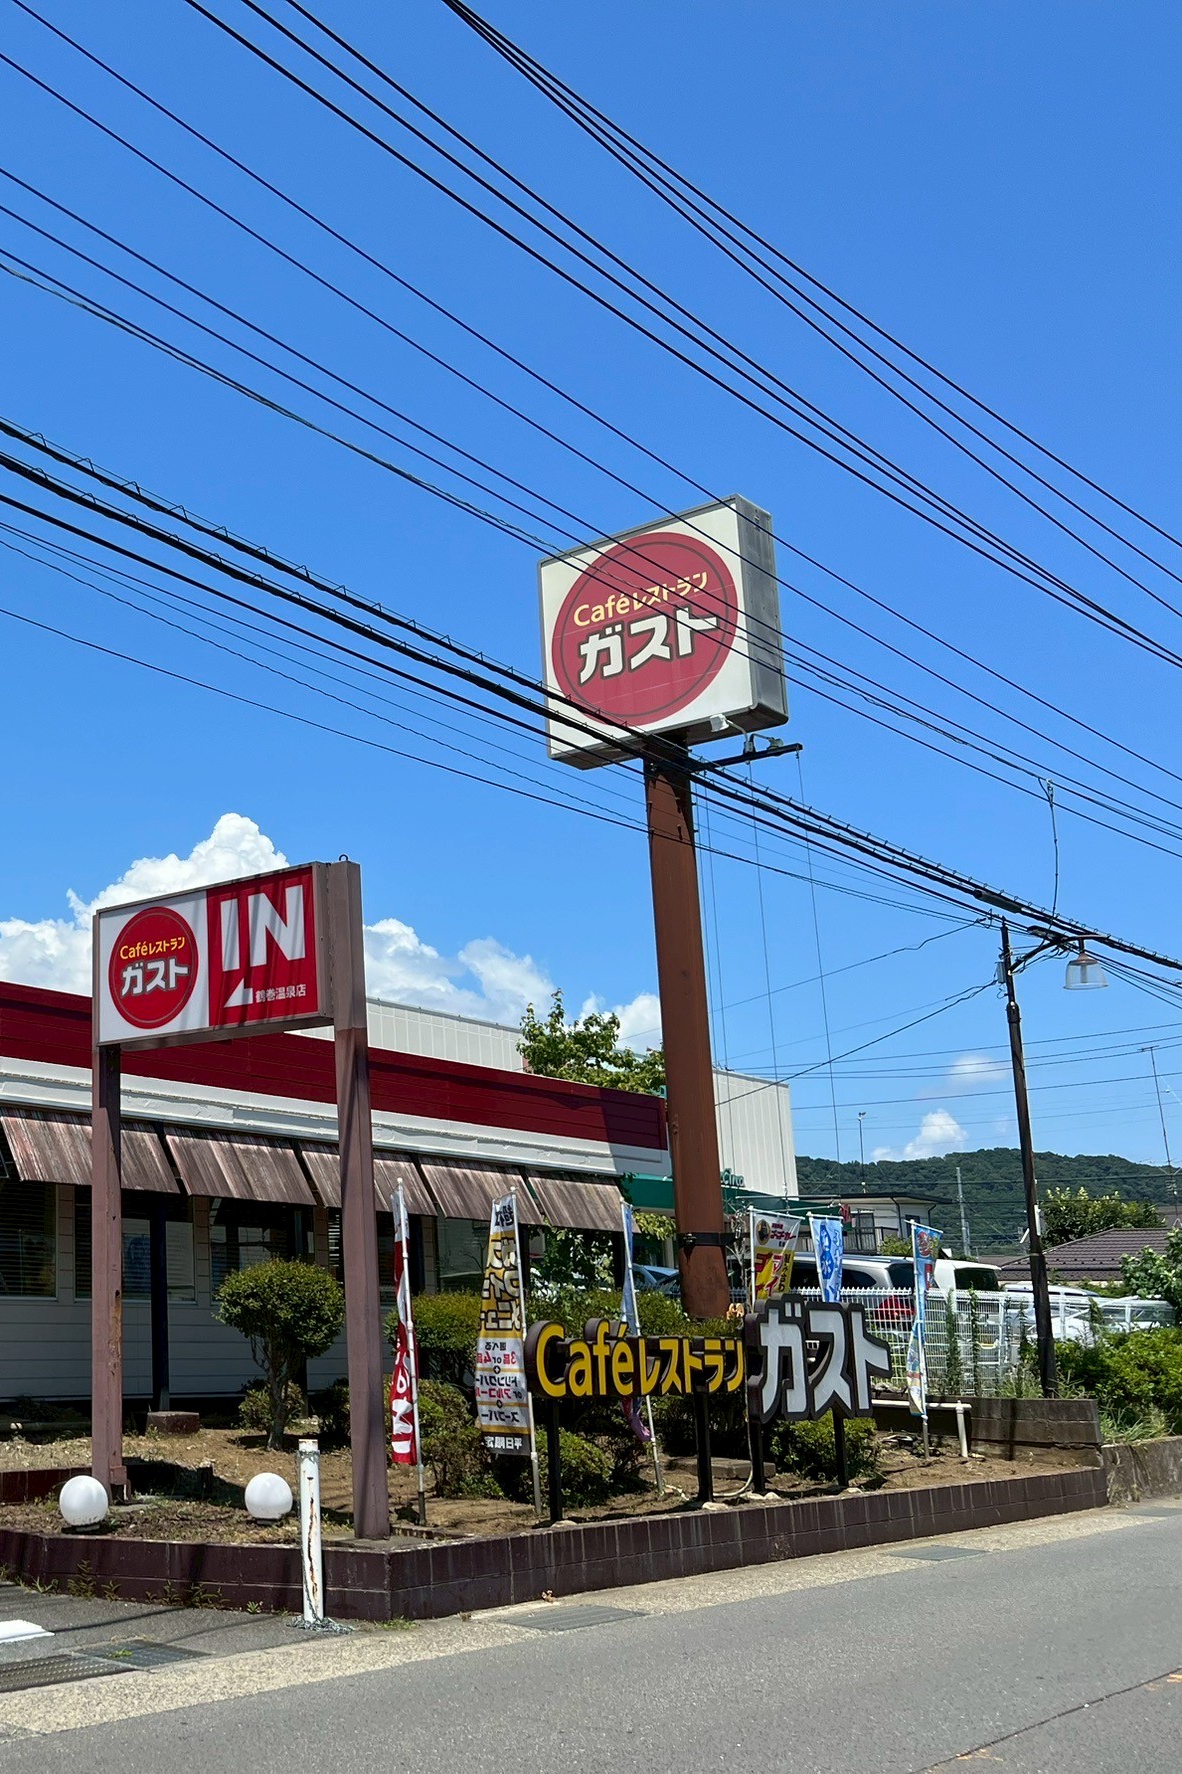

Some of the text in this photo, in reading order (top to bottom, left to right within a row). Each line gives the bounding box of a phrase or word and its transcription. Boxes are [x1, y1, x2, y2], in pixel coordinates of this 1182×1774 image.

[579, 605, 719, 686] ガスト
[219, 884, 306, 972] IN
[121, 957, 189, 997] ガスト
[255, 983, 307, 1003] 鶴巻温泉店
[760, 1302, 890, 1414] ガスト
